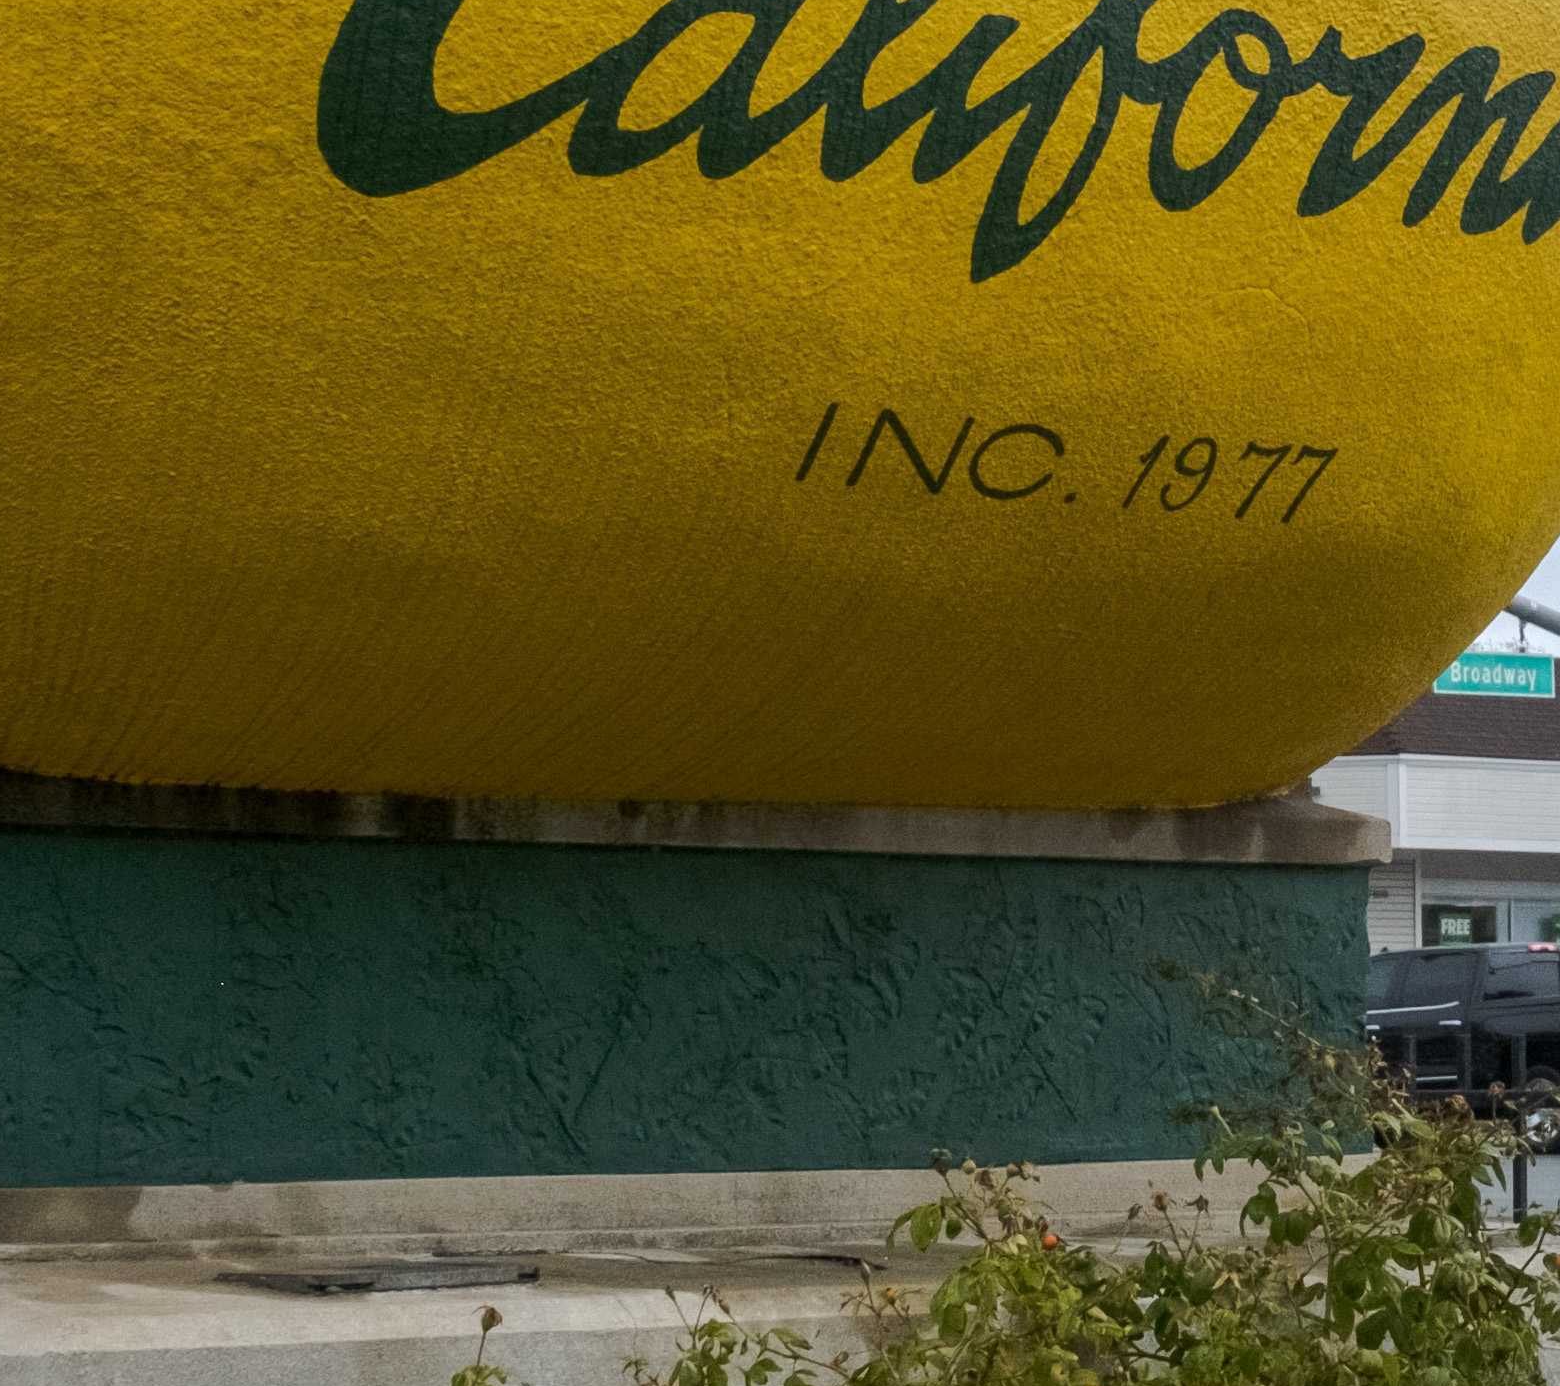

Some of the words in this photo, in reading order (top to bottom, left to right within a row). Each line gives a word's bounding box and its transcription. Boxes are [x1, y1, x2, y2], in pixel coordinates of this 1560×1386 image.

[795, 401, 1077, 506] INC.
[1122, 434, 1339, 524] 1977
[1450, 660, 1537, 692] Broadway
[1440, 917, 1472, 936] FREE
